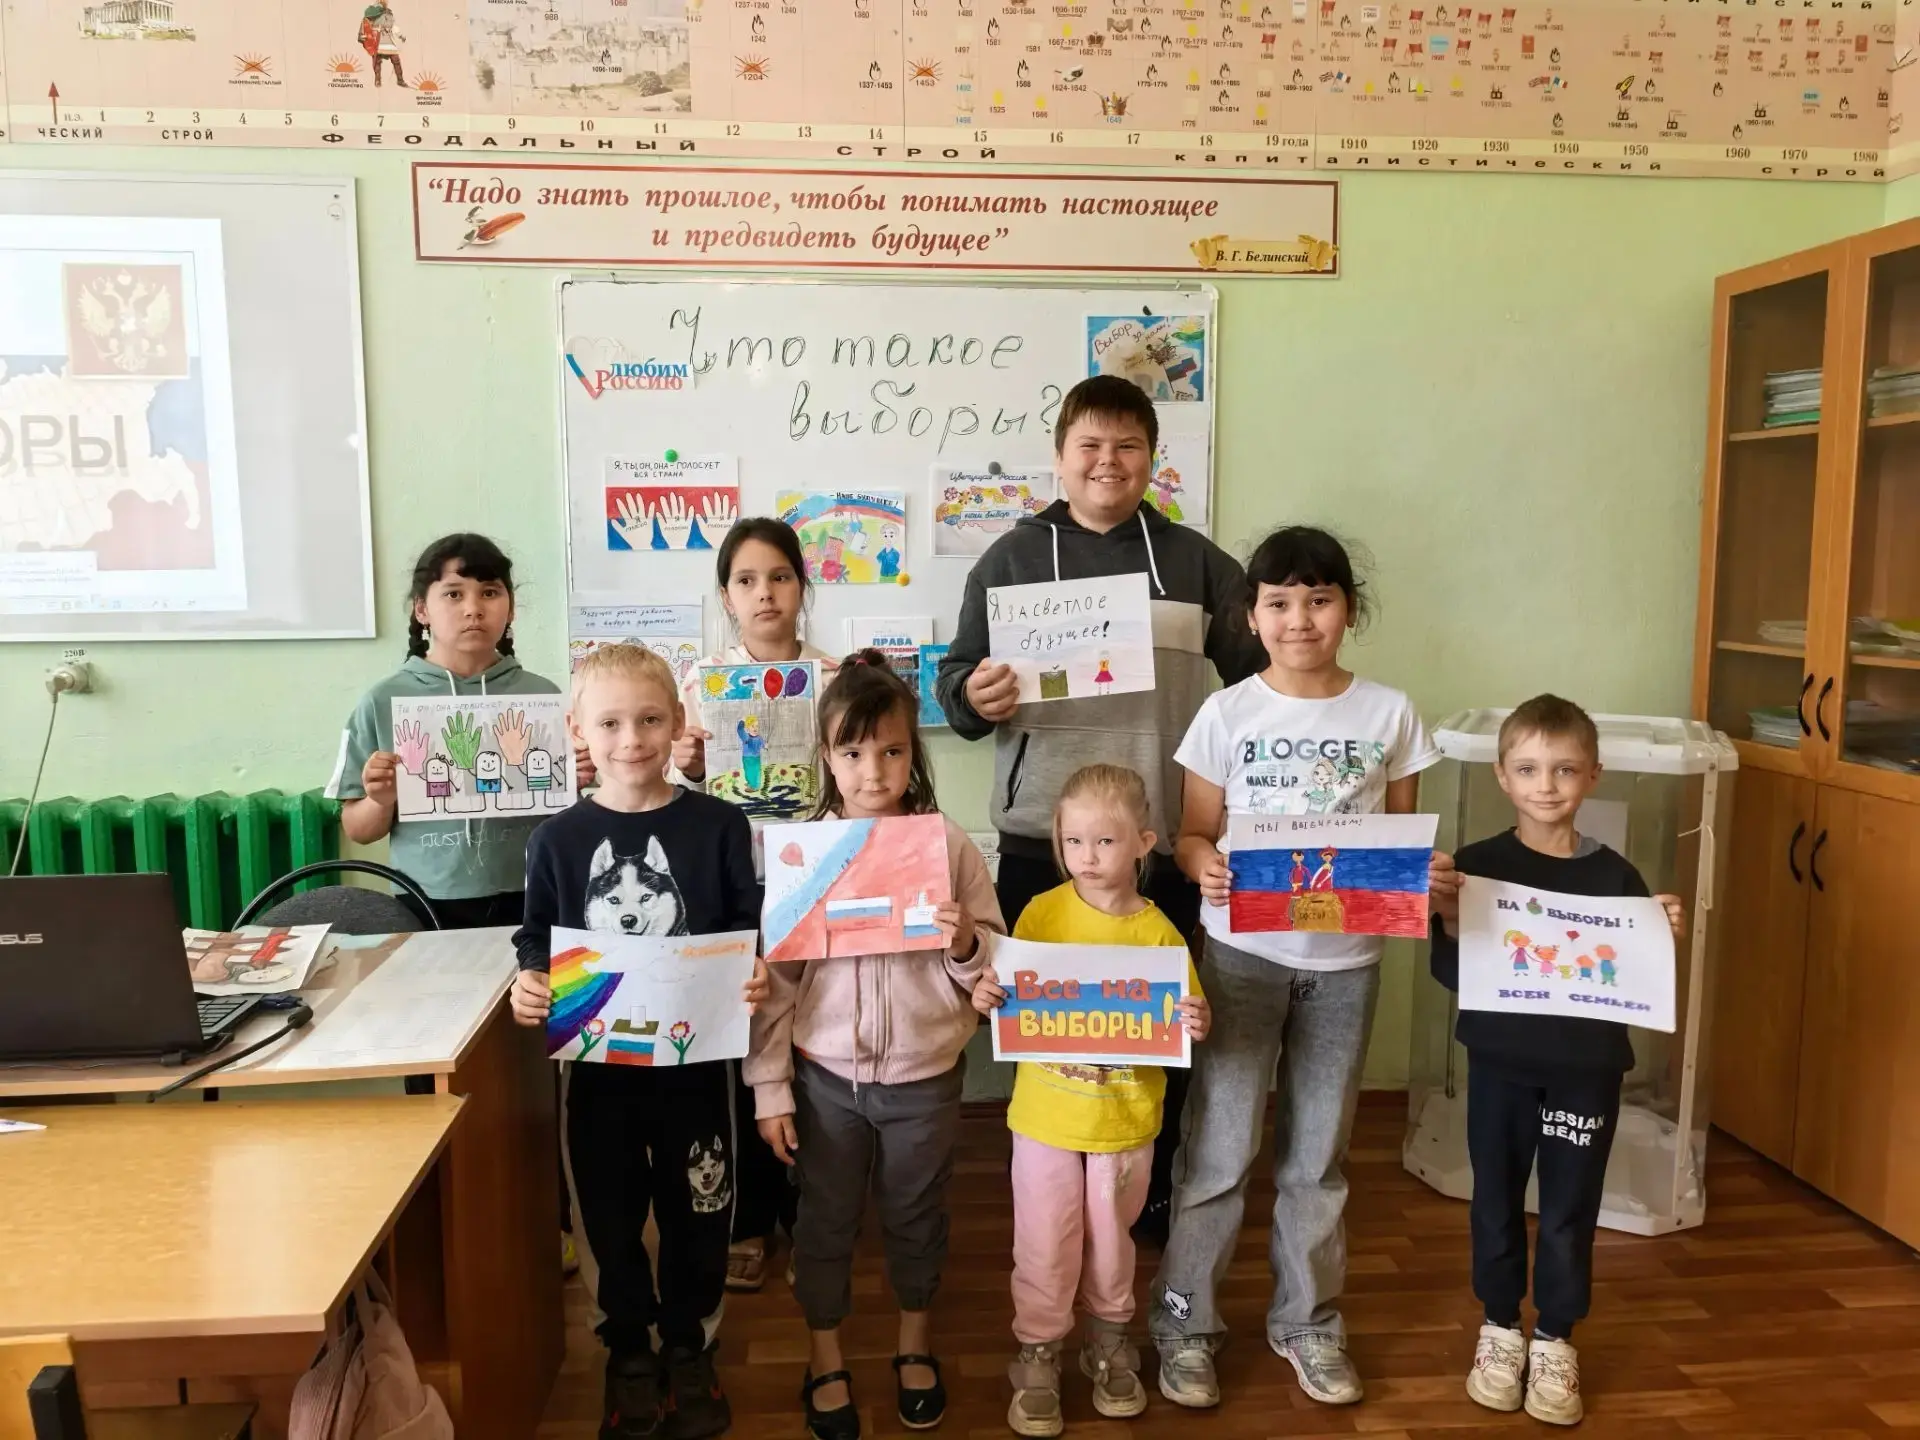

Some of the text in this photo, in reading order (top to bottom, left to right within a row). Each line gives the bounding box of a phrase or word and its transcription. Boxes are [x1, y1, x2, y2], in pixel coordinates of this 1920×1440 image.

[100, 110, 106, 122] 1
[146, 111, 155, 123] 2
[192, 112, 201, 124] 3
[238, 113, 248, 126] 4
[284, 114, 292, 126] 5
[331, 114, 340, 126] 6
[376, 115, 386, 128] 7
[422, 116, 430, 128] 8
[508, 118, 516, 130] 9
[580, 120, 594, 132] 10
[654, 123, 667, 134] 11
[726, 124, 740, 136] 12
[162, 128, 214, 140] СТРОЙ
[798, 126, 812, 138] 13
[869, 128, 883, 140] 14
[974, 130, 988, 142] 15
[1050, 132, 1064, 143] 16
[1128, 134, 1140, 144] 17
[1200, 135, 1213, 146] 18
[1266, 135, 1309, 147] 19 года
[1340, 138, 1368, 150] 1910
[1412, 140, 1438, 150] 1920
[1482, 140, 1510, 152] 1930
[1553, 142, 1580, 154] 1940
[1624, 144, 1648, 156] 1950
[1725, 148, 1750, 158] 1960
[1782, 150, 1808, 160] 1970
[1853, 152, 1878, 162] 1980
[428, 176, 1219, 222] “Надо знать прошлое, чтобы понимать настоящее
[652, 221, 1008, 256] и предвидеть будущее”
[1216, 250, 1309, 263] В. Г. Белинский
[670, 306, 1024, 373] Что такое
[610, 357, 690, 378] любим
[594, 370, 684, 390] Россию
[988, 592, 1001, 621] Я
[872, 638, 912, 646] ПРАВА
[1244, 738, 1384, 765] BLOGGERS
[1246, 776, 1299, 788] MAKE UP
[1496, 898, 1520, 912] НА
[1014, 970, 1150, 1002] Все на
[1542, 1124, 1592, 1146] BEAR
